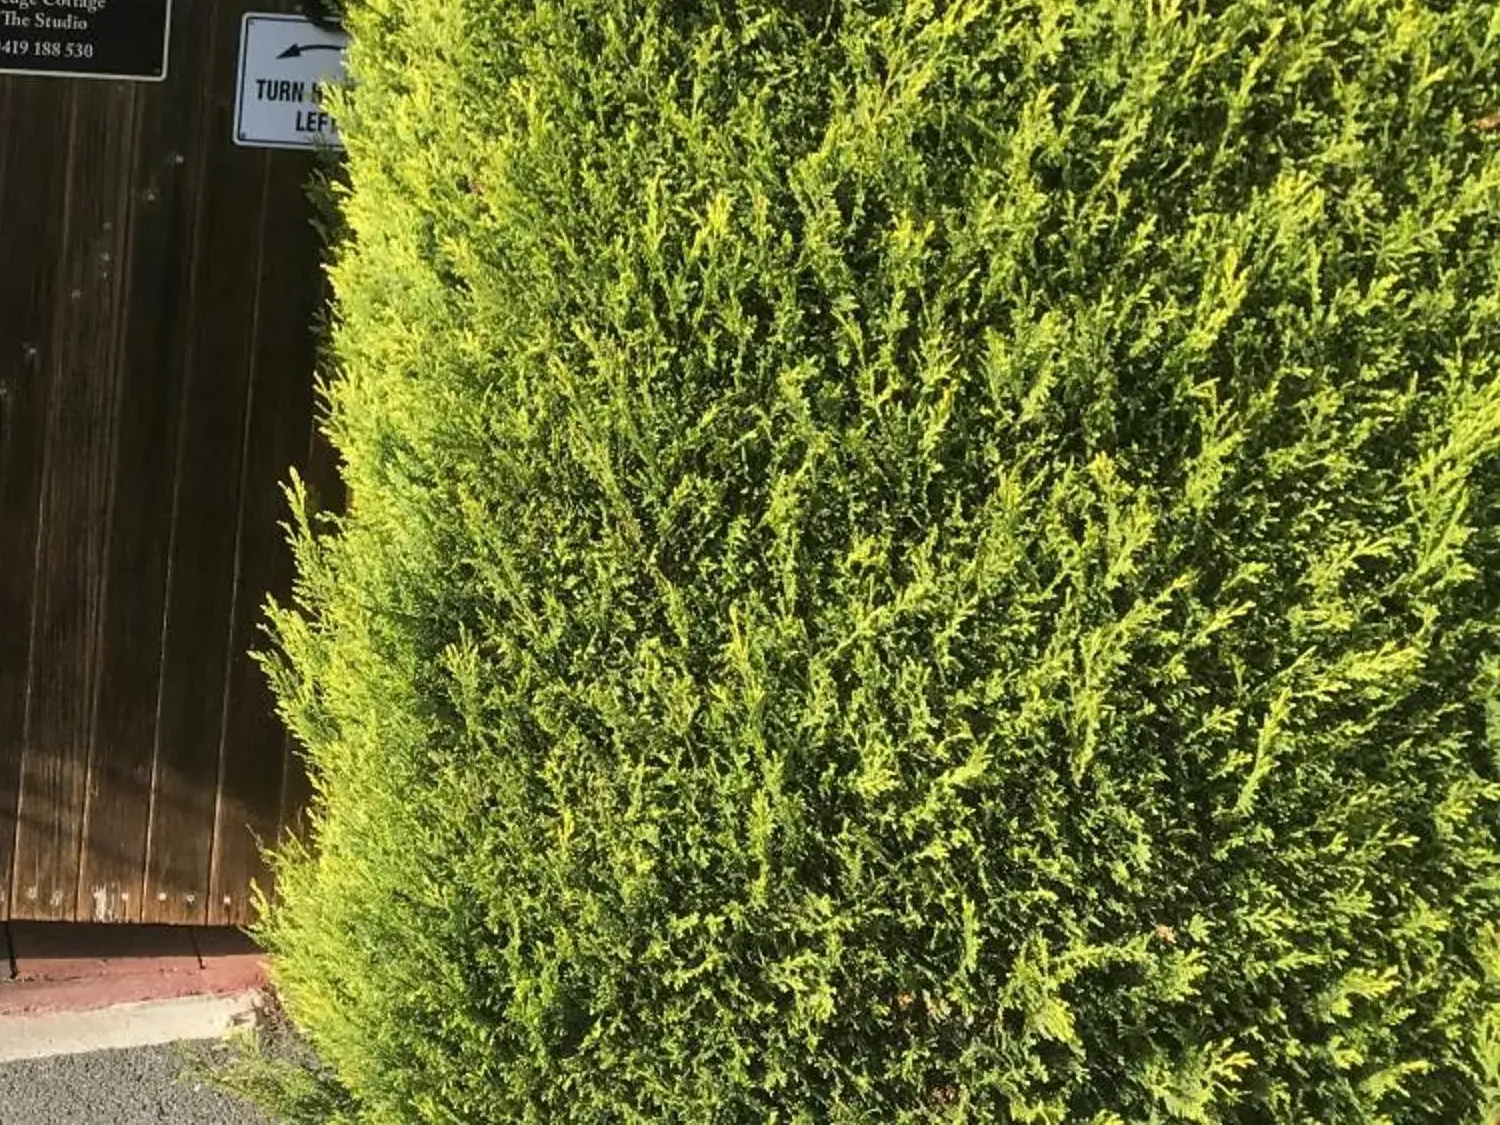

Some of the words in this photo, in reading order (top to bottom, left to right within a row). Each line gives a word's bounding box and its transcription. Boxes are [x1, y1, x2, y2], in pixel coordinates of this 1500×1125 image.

[1, 10, 30, 27] The
[34, 12, 88, 30] Studio
[33, 41, 61, 57] 188
[63, 41, 94, 58] 530
[256, 78, 305, 103] TURN
